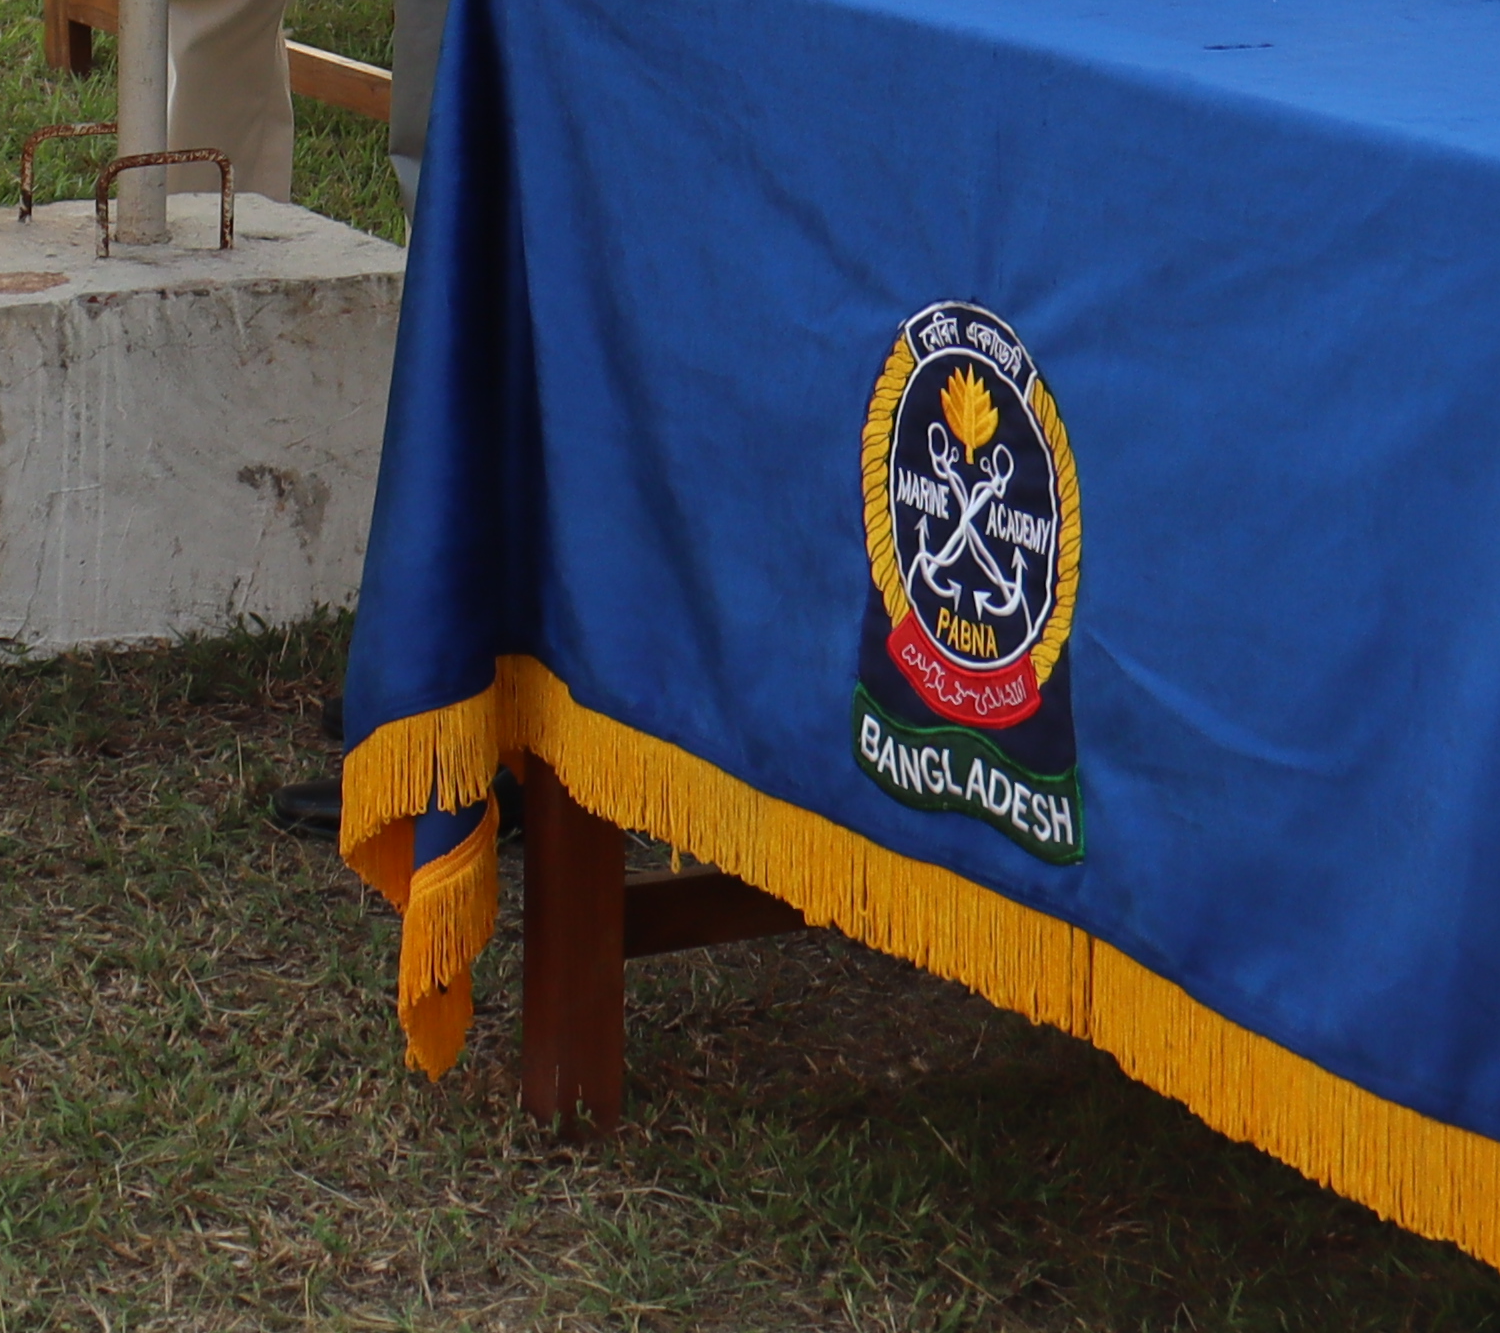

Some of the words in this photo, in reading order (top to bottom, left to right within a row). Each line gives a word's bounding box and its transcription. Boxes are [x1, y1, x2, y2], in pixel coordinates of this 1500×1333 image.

[896, 467, 950, 521] MARINE
[985, 501, 1051, 555] ACADEMY
[935, 606, 999, 659] PABNA
[859, 713, 1074, 846] BANGLADESH
